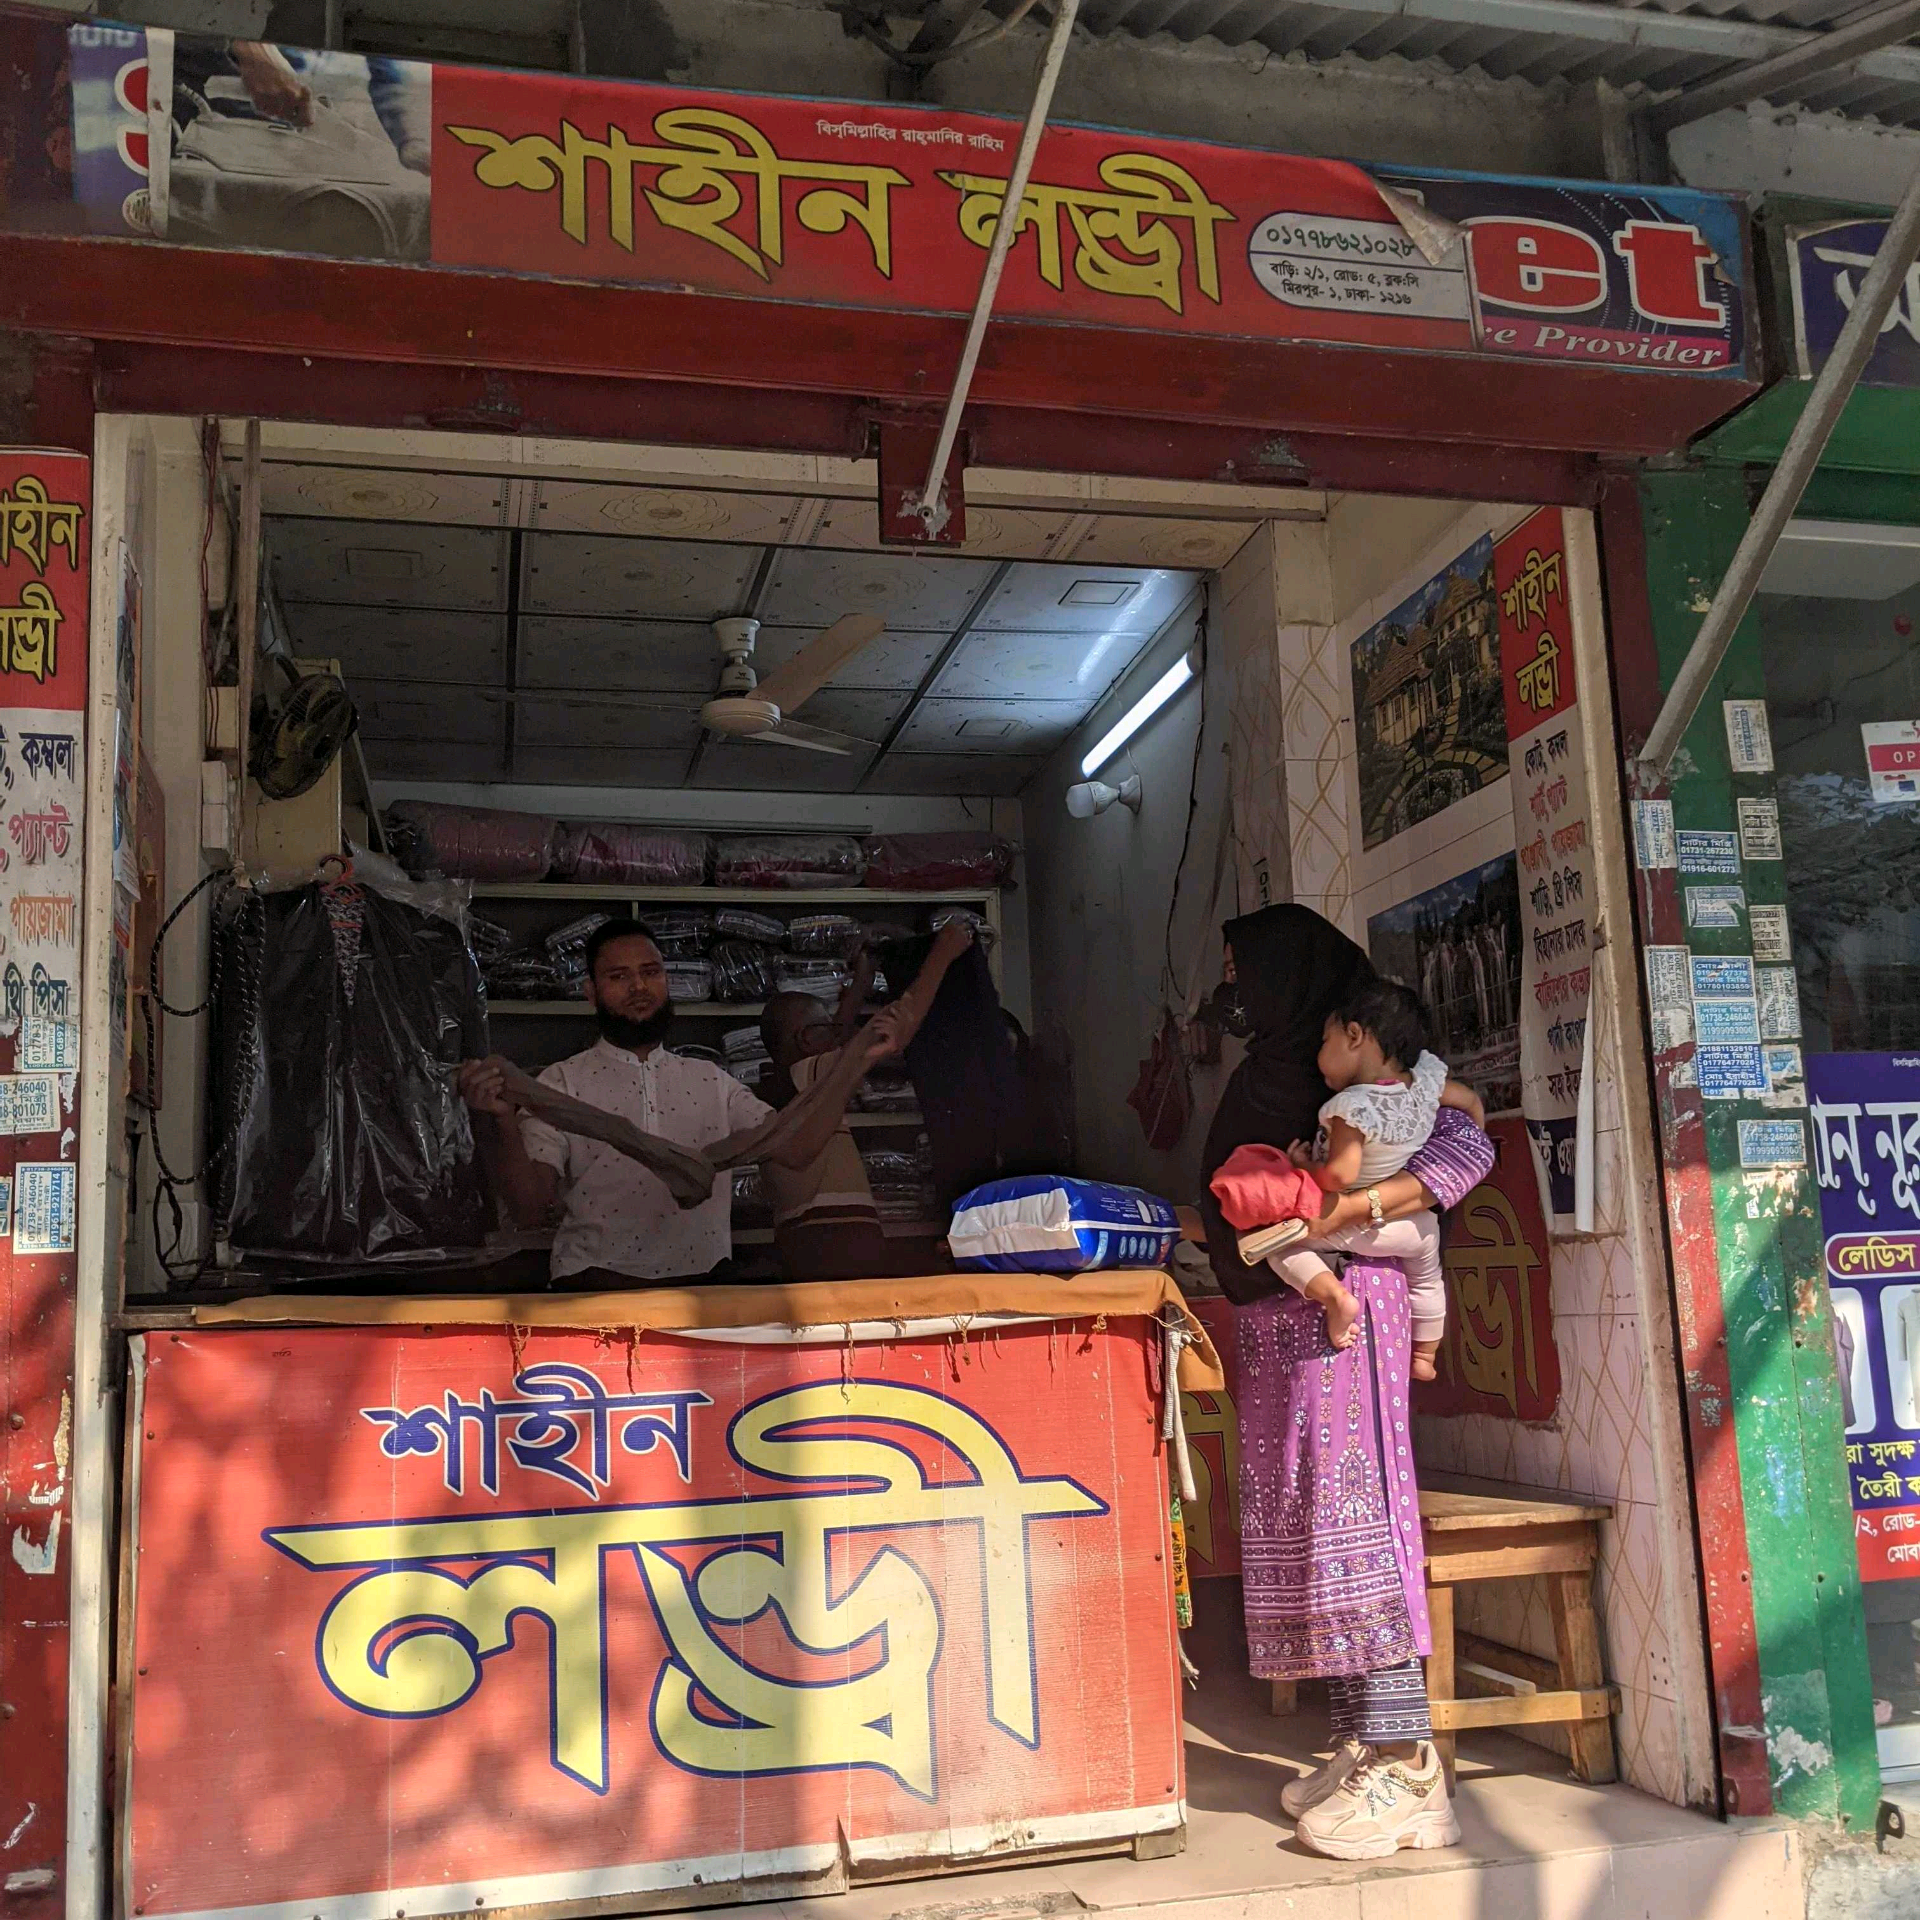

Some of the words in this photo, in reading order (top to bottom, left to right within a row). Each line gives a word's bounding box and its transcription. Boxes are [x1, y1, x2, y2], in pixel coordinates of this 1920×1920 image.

[446, 105, 911, 283] শাহীন
[1533, 326, 1722, 366] Provider
[0, 475, 84, 577] াহীন
[1501, 549, 1562, 632] শাহীন
[19, 732, 76, 781] কম্বল
[28, 1173, 37, 1242] 01738-246040
[1838, 1236, 1917, 1271] লেডিস
[360, 1362, 715, 1502] শাহীন
[1867, 1440, 1916, 1467] সুদক্ষ
[1857, 1471, 1903, 1499] তৈরী
